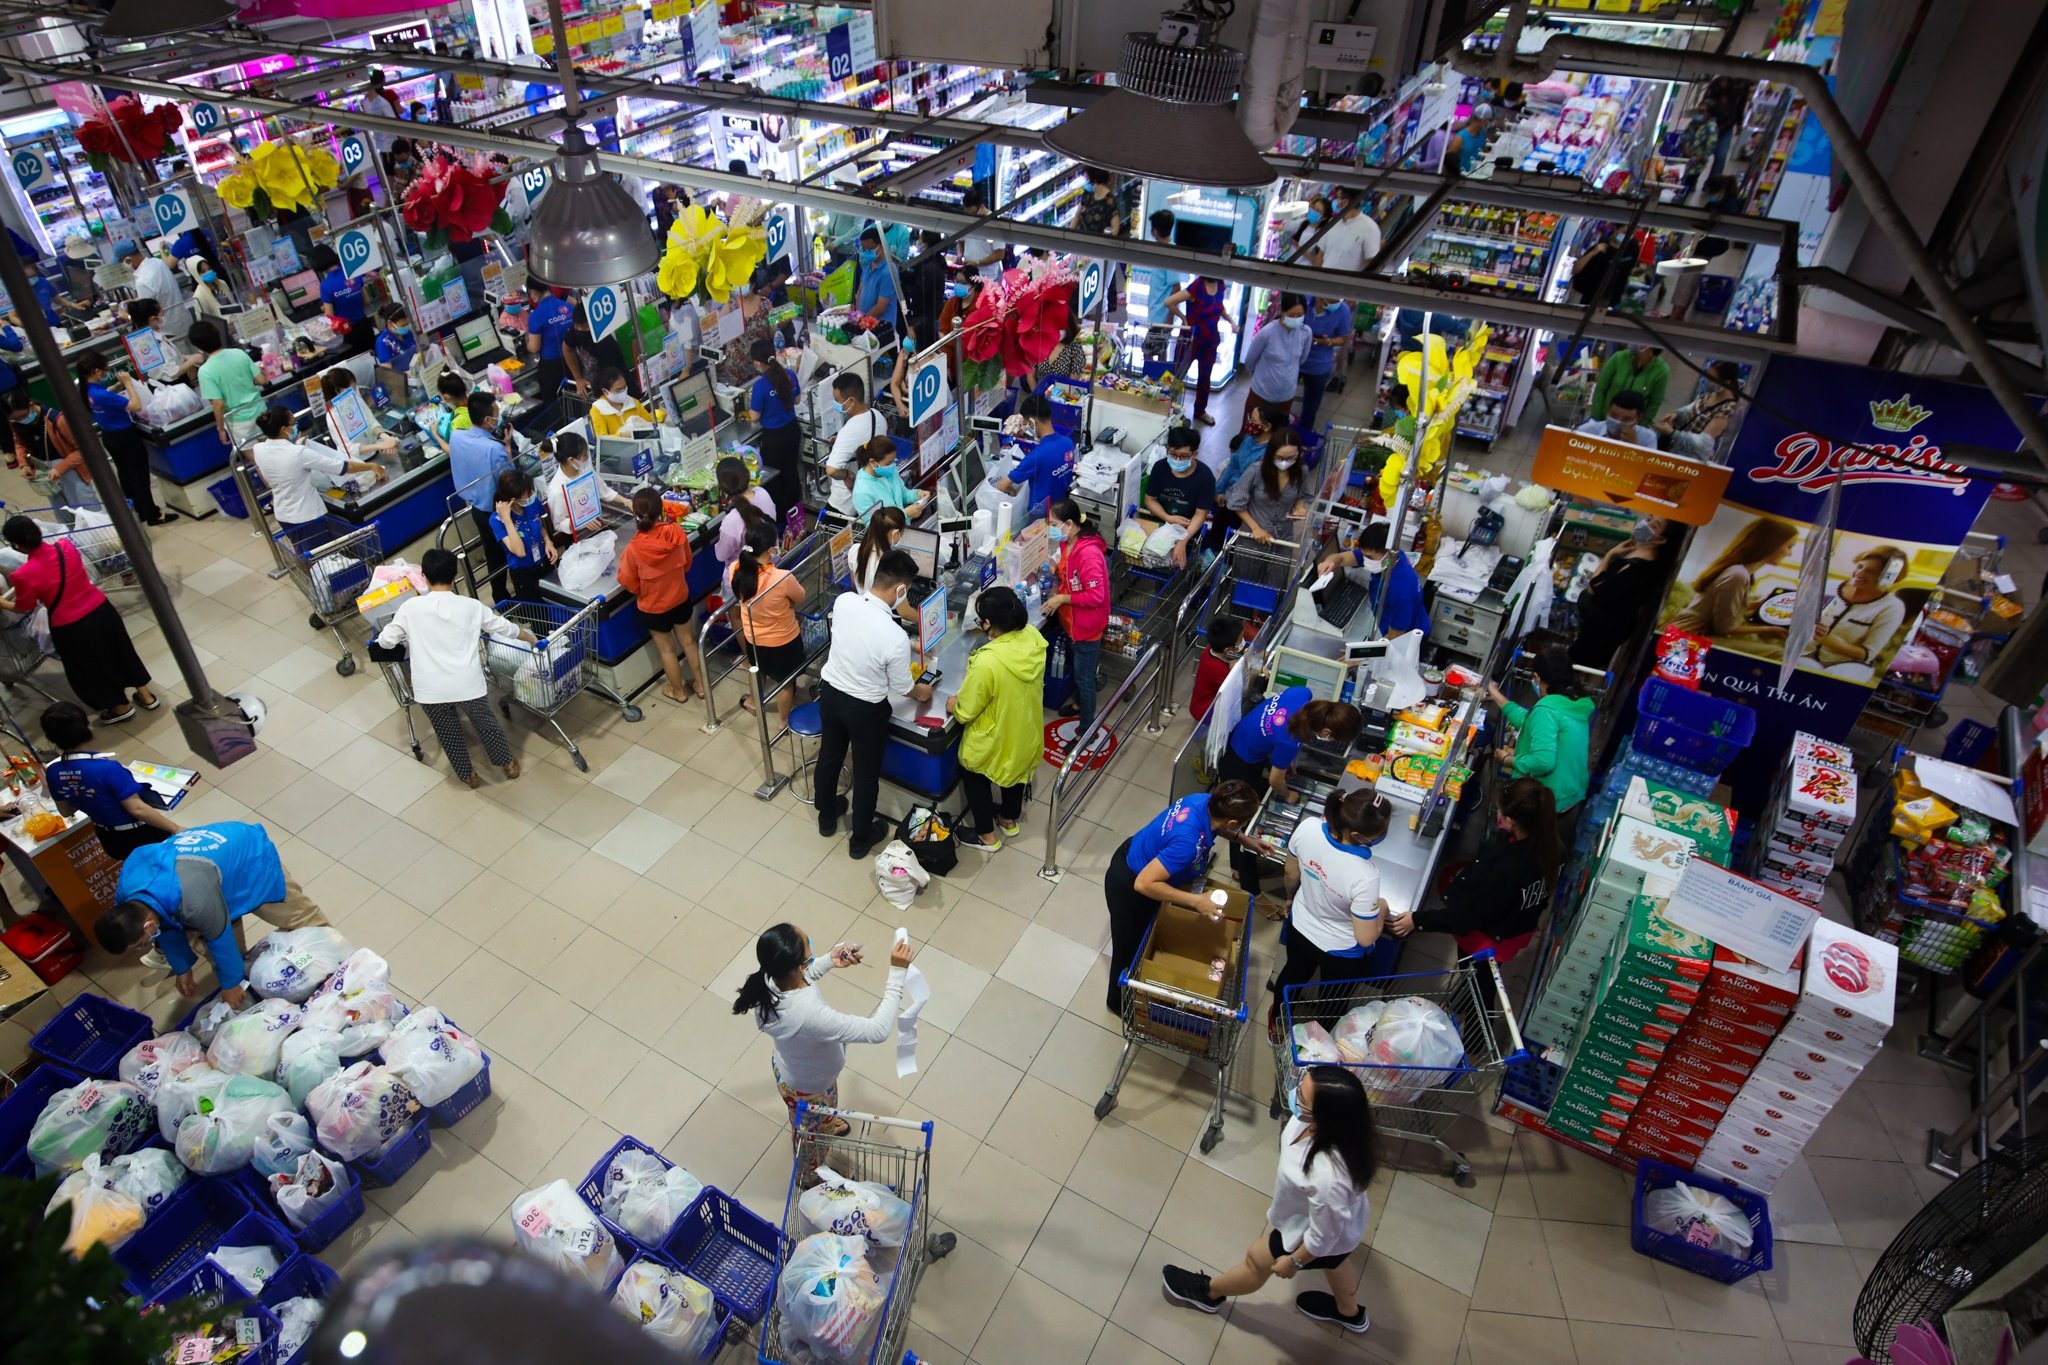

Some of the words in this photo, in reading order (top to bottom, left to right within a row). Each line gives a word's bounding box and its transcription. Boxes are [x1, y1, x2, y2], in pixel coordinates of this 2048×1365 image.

[831, 53, 850, 78] 02
[194, 108, 214, 127] 01
[343, 145, 363, 165] 03
[16, 157, 40, 178] 02
[524, 166, 545, 189] 05
[158, 200, 184, 221] 04
[769, 224, 787, 247] 07
[342, 241, 367, 262] 06
[1084, 272, 1098, 297] 09
[591, 297, 614, 322] 08
[916, 375, 936, 402] 10
[1677, 464, 1700, 478] cho
[295, 953, 313, 969] 594
[1636, 951, 1674, 970] SAIGON
[1627, 975, 1665, 994] SAIGON
[1720, 974, 1760, 993] SAIGON
[1616, 995, 1653, 1013] SAIGON
[1708, 995, 1748, 1014] SAIGON
[1603, 1012, 1640, 1031] SAIGON
[1597, 1032, 1633, 1050] SAIGON
[1589, 1049, 1624, 1067] SAIGON
[1675, 1054, 1712, 1072] SAIGON
[1580, 1066, 1615, 1085] SAIGON
[1664, 1072, 1701, 1090] SAIGON
[83, 1090, 99, 1107] 309
[1572, 1083, 1606, 1101] SAIGON
[1654, 1089, 1690, 1108] SAIGON
[1565, 1100, 1598, 1118] SAIGON
[1645, 1108, 1681, 1126] SAIGON
[1558, 1116, 1590, 1134] SAIGON
[1636, 1124, 1670, 1143] SAIGON
[1627, 1140, 1661, 1158] SAIGON
[521, 1208, 540, 1229] 308
[577, 1230, 591, 1251] 012
[244, 1319, 255, 1343] 225
[182, 1341, 196, 1363] 400
